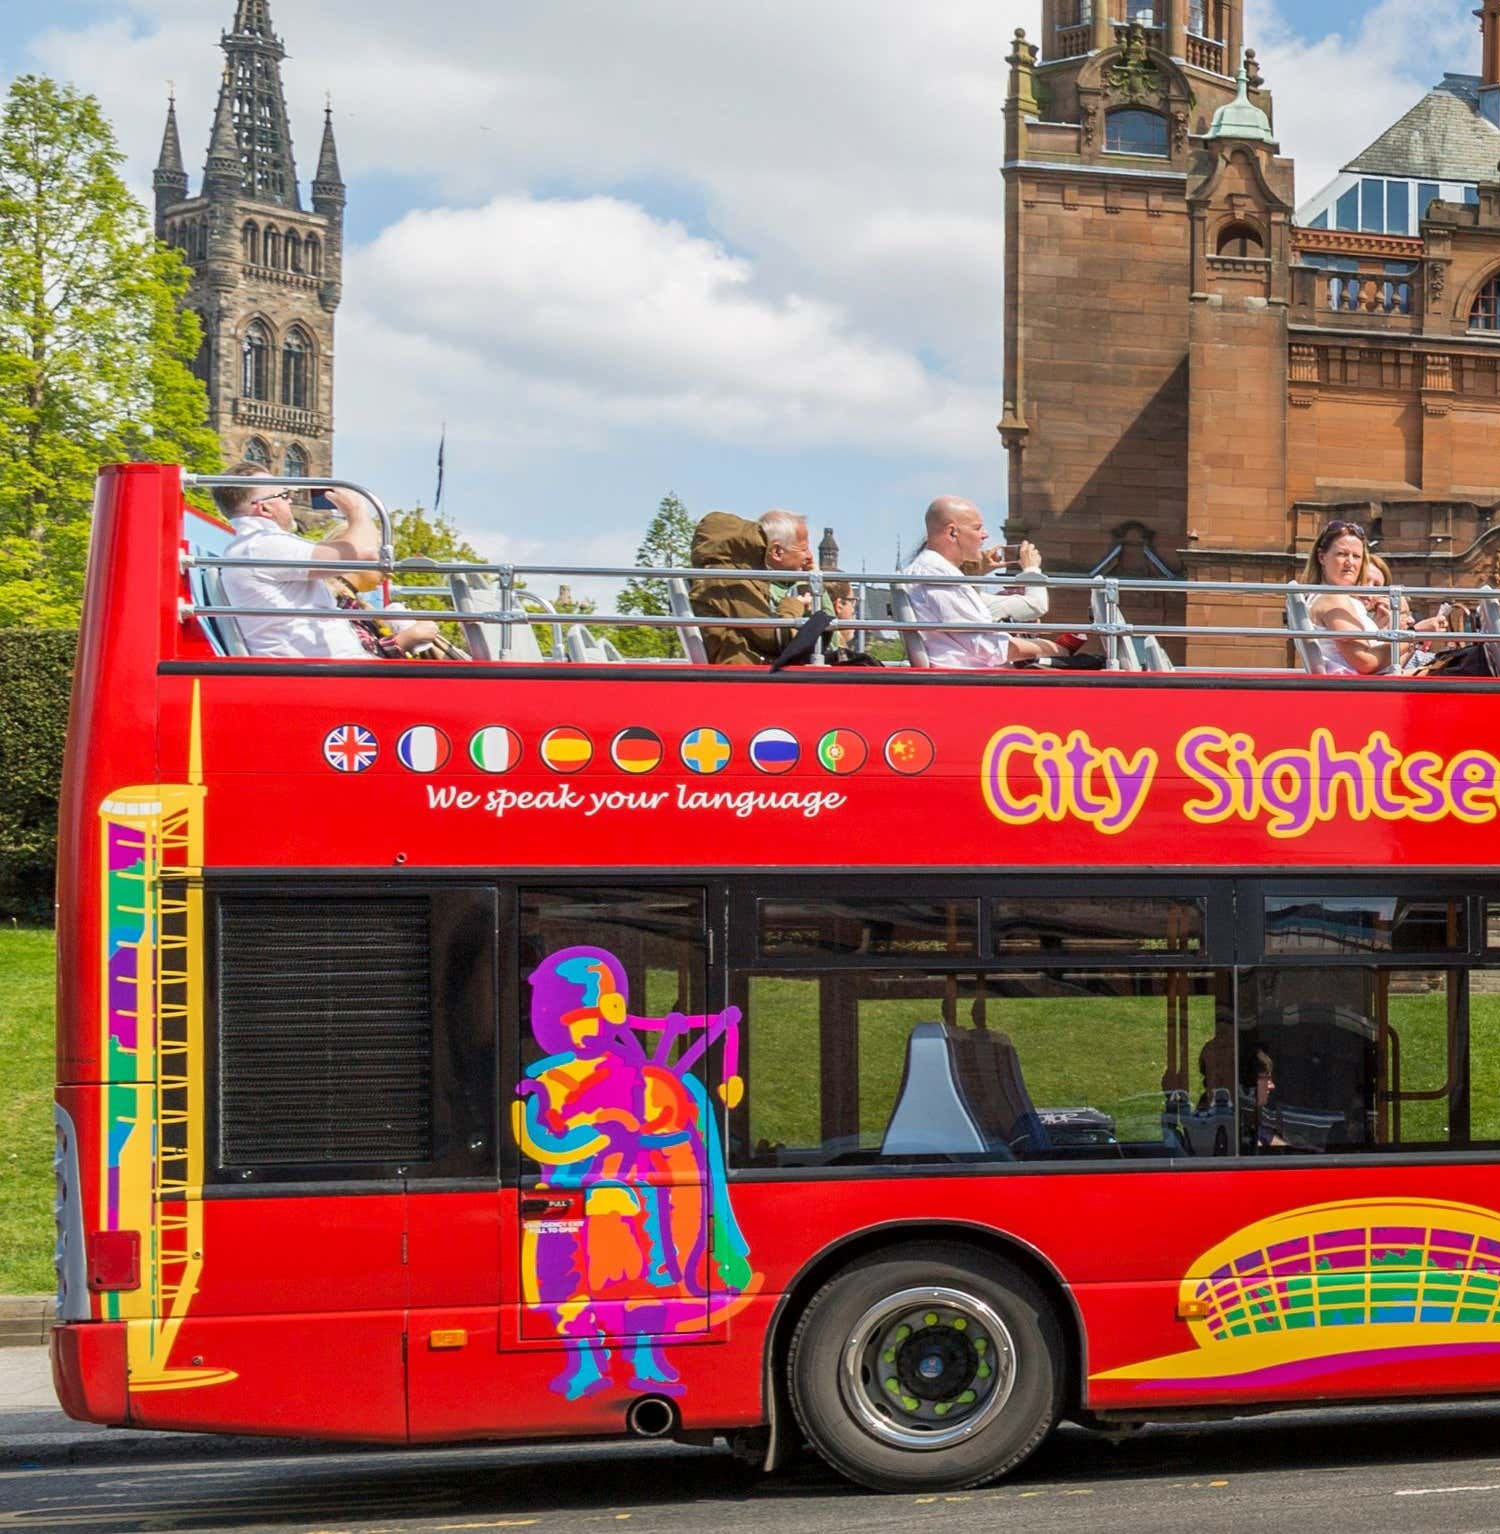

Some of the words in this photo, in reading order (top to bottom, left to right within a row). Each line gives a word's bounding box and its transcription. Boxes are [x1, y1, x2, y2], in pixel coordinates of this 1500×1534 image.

[426, 784, 480, 809] We
[484, 783, 586, 817] speak
[584, 791, 670, 817] your
[676, 784, 848, 818] language
[981, 724, 1159, 836] City
